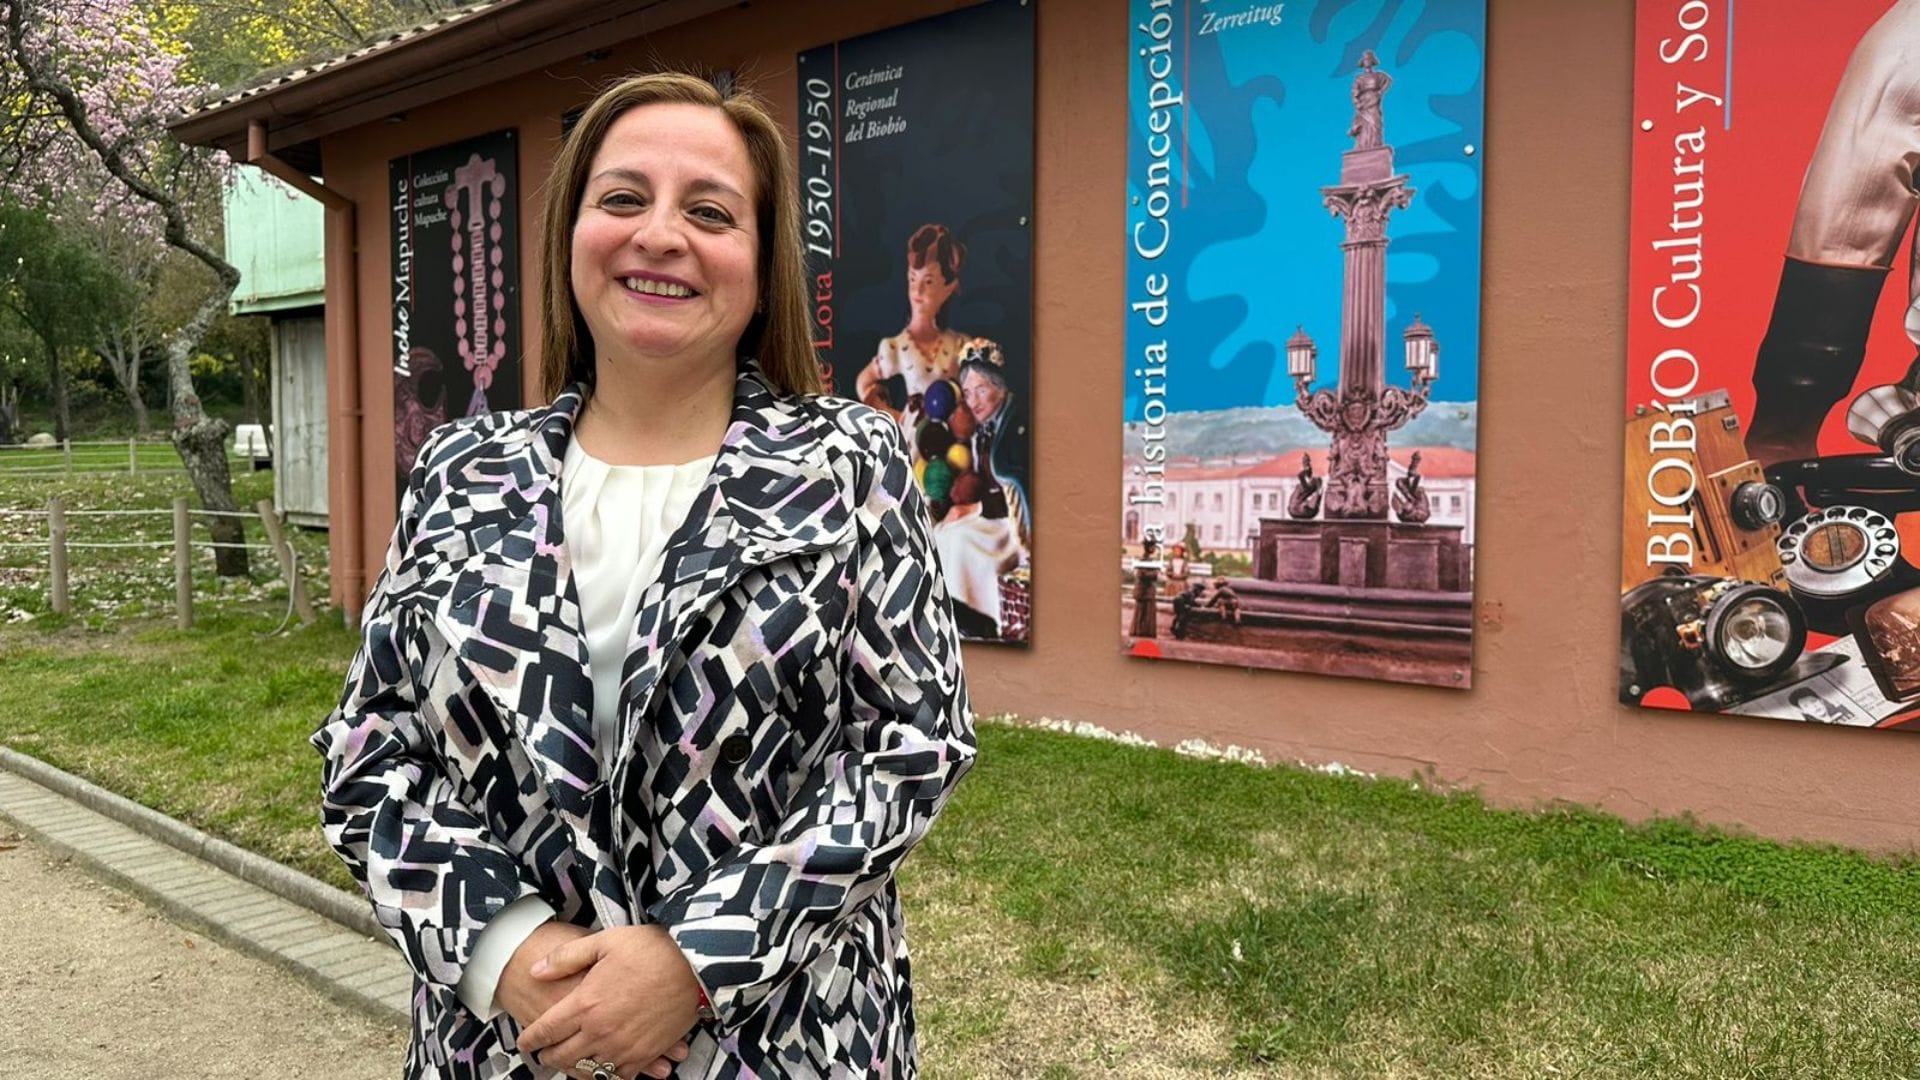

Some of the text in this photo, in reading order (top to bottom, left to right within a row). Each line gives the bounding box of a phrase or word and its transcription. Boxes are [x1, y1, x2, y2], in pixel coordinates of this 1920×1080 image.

[1199, 4, 1284, 35] Zerreitug
[1659, 0, 1709, 63] So
[845, 65, 903, 90] Cerámica
[1676, 81, 1723, 113] y
[845, 87, 899, 119] Regional
[845, 116, 907, 143] del Biobío
[806, 78, 832, 258] 1930-1950
[414, 208, 448, 228] Mapuche
[1651, 126, 1706, 328] Cultura
[393, 178, 414, 377] Inche Mapuche
[1133, 273, 1168, 326] de
[813, 271, 833, 349] Lota
[1130, 340, 1168, 508] historia
[1131, 524, 1164, 570] La
